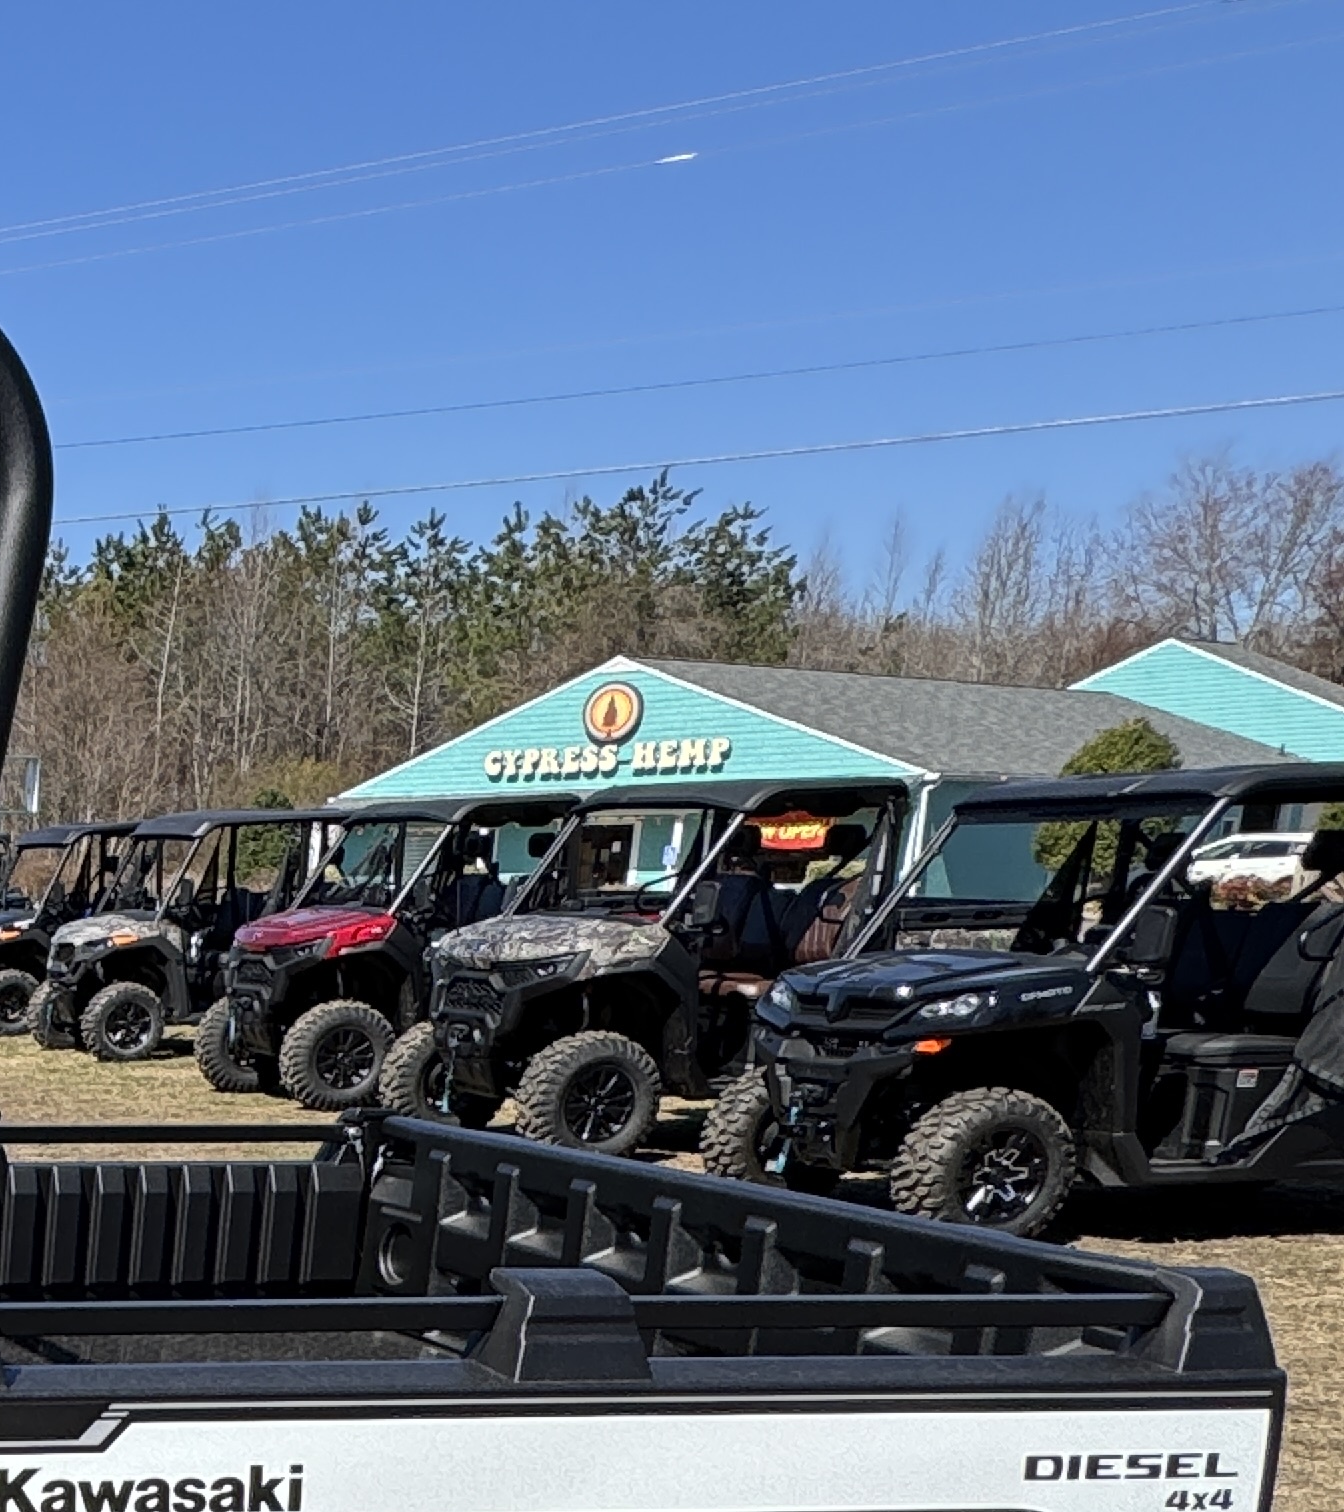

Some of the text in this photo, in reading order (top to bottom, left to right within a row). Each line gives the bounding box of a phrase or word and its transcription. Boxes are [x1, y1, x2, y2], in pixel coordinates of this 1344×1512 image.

[484, 736, 731, 780] CYPRESS HEMP
[1023, 1452, 1238, 1481] DIESEL
[1164, 1488, 1234, 1511] 4x4
